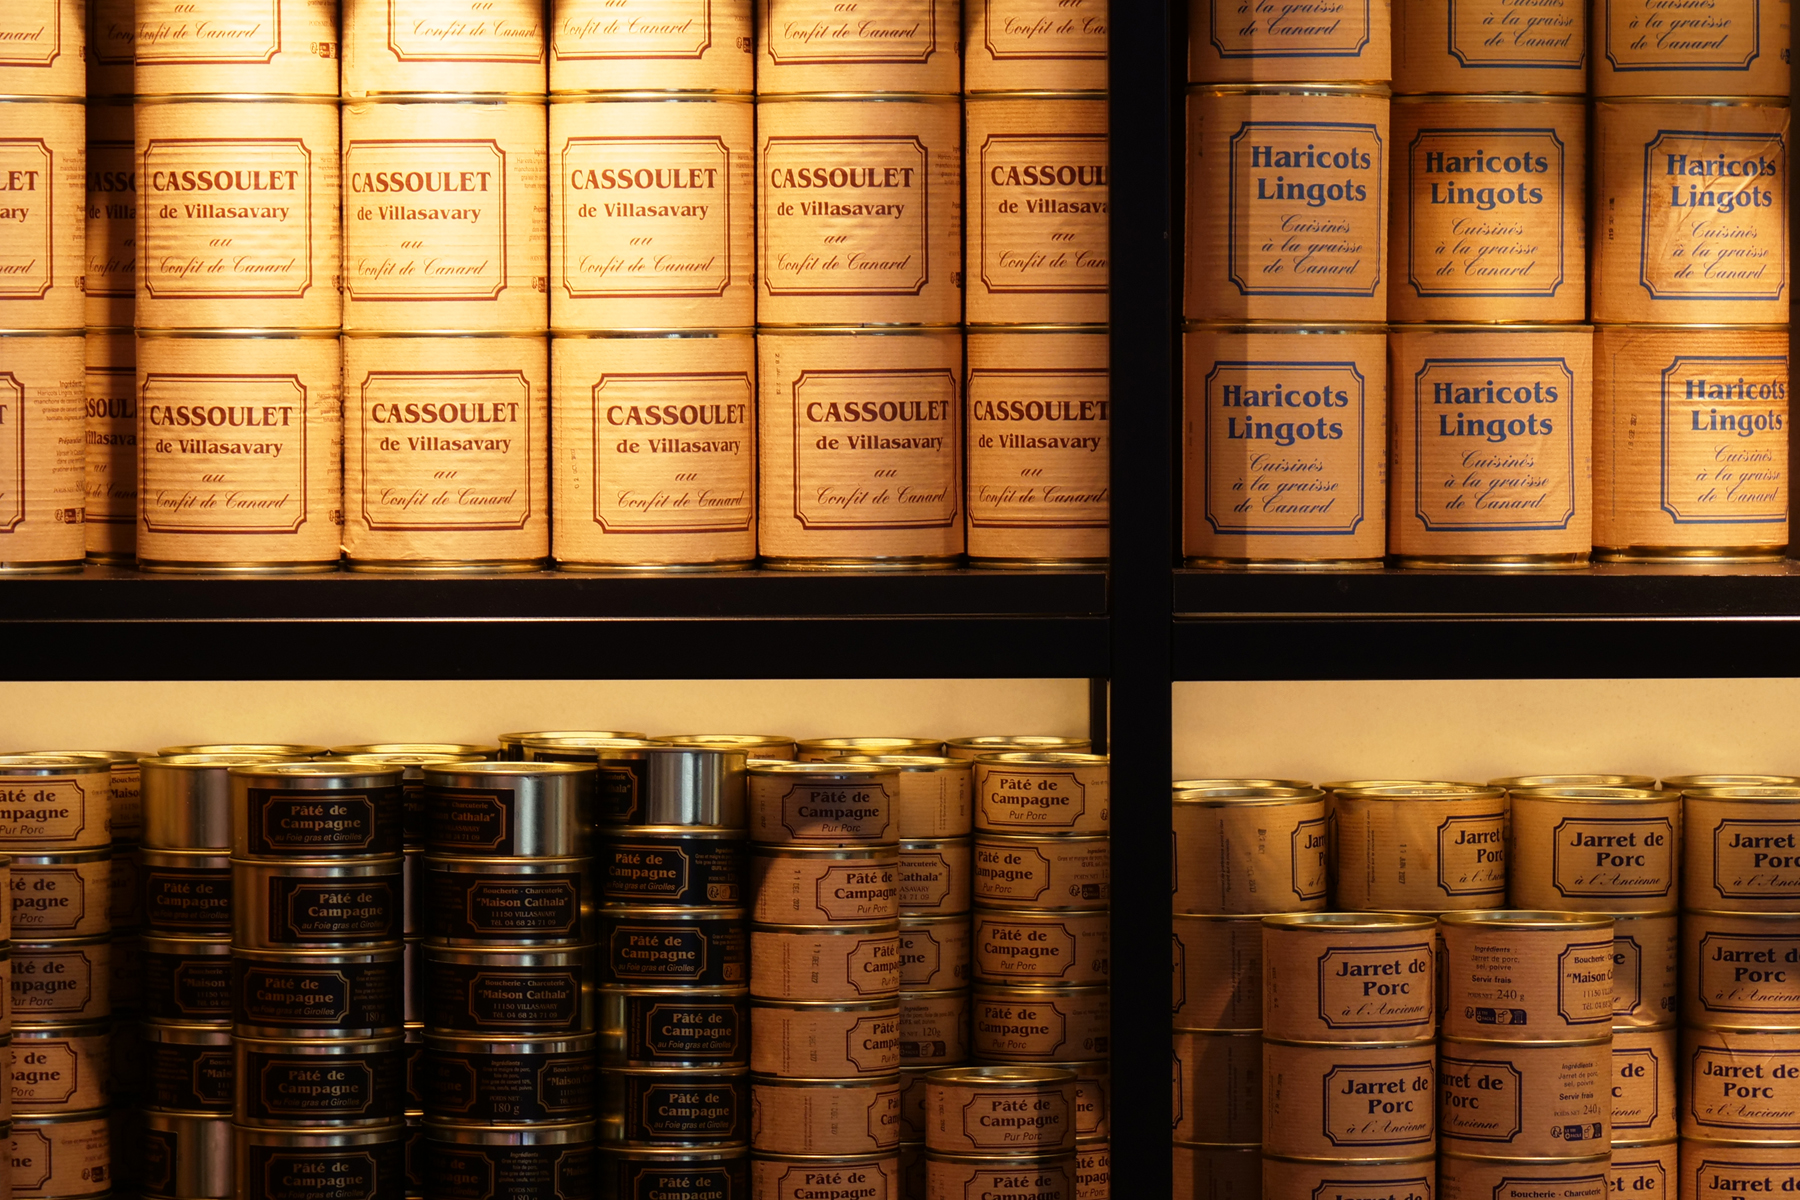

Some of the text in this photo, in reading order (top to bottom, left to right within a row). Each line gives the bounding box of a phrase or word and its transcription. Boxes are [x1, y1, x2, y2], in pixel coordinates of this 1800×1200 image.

[1629, 12, 1732, 32] à la graisse
[1630, 31, 1728, 50] de Canard
[1251, 144, 1372, 170] Haricots
[1426, 149, 1548, 174] Haricots
[1666, 154, 1776, 176] Haricots
[153, 171, 298, 192] CASSOULET
[352, 172, 492, 192] CASSOULET
[571, 169, 718, 190] CASSOULET
[771, 168, 914, 188] CASSOULET
[1257, 176, 1368, 208] Lingots
[1431, 181, 1544, 211] Lingots
[1671, 184, 1772, 214] Lingots
[160, 204, 290, 222] de Villasavary
[357, 205, 482, 224] de Villasavary
[578, 202, 710, 220] de Villasavary
[777, 201, 906, 220] de Villasavary
[1281, 214, 1350, 234] Cuisinés
[209, 238, 232, 248] au
[1261, 236, 1362, 258] à la graisse
[160, 256, 296, 278] Confit de Canard
[1263, 256, 1360, 274] de Canard
[1223, 383, 1349, 408] Haricots
[1433, 380, 1558, 404] Haricots
[1685, 377, 1786, 400] Haricots
[150, 405, 294, 426] CASSOULET
[372, 403, 520, 424] CASSOULET
[607, 404, 746, 426] CASSOULET
[807, 400, 950, 422] CASSOULET
[1228, 415, 1344, 447] Lingots
[1439, 412, 1554, 443] Lingots
[1691, 408, 1782, 438] Lingots
[156, 439, 284, 458] de Villasavary
[380, 436, 512, 454] de Villasavary
[816, 435, 944, 452] de Villasavary
[979, 433, 1100, 452] de Villasavary
[1461, 450, 1534, 468] Cuisinés
[434, 471, 458, 480] au
[1444, 471, 1549, 492] à la graisse
[381, 488, 518, 510] Confit de Canard
[1445, 492, 1547, 510] de Canard
[1000, 779, 1058, 790] Pâté de
[810, 791, 870, 803] Pâté de
[991, 793, 1070, 808] Campagne
[291, 804, 348, 816] Pâté de
[798, 806, 880, 821] Campagne
[1009, 810, 1047, 820] Pur Porc
[280, 818, 361, 832] Campagne
[821, 823, 861, 832] Pur Porc
[1570, 832, 1664, 848] Jarret de
[1729, 833, 1796, 848] Jarret
[1596, 852, 1646, 867] Porc
[846, 872, 893, 884] Pâté de
[1574, 876, 1584, 885] à
[857, 903, 888, 914] Pur Porc
[629, 936, 682, 947] Pâté de
[992, 928, 1048, 942] Pâté de
[621, 948, 696, 962] Campagne
[984, 943, 1060, 958] Campagne
[1470, 954, 1490, 962] Jarret
[1712, 947, 1777, 964] Jarret
[658, 964, 666, 972] et
[667, 963, 695, 972] Girolles
[1336, 959, 1426, 977] Jarret de
[1574, 955, 1605, 964] Boucherie
[527, 979, 566, 987] Charcuterie
[1472, 975, 1512, 984] Servir frais
[1735, 967, 1787, 983] Porc
[1363, 982, 1410, 996] Porc
[1497, 989, 1518, 1000] 240
[673, 1013, 722, 1024] Pâté de
[1342, 1006, 1350, 1016] à
[661, 1025, 732, 1039] Campagne
[288, 1070, 346, 1082] Pâté de
[1703, 1061, 1800, 1079] Jarret de
[278, 1082, 360, 1096] Campagne
[1341, 1076, 1428, 1094] Jarret de
[1723, 1082, 1774, 1099] Porc
[1445, 1091, 1480, 1110] Porc
[1559, 1092, 1594, 1101] Servir frais
[992, 1099, 1050, 1112] Pâté de
[1368, 1099, 1414, 1114] Porc
[1583, 1103, 1598, 1115] 240
[1706, 1104, 1714, 1114] à
[980, 1114, 1060, 1128] Campagne
[1004, 1132, 1042, 1141] Pur Porc
[1510, 1190, 1556, 1198] Boucherie
